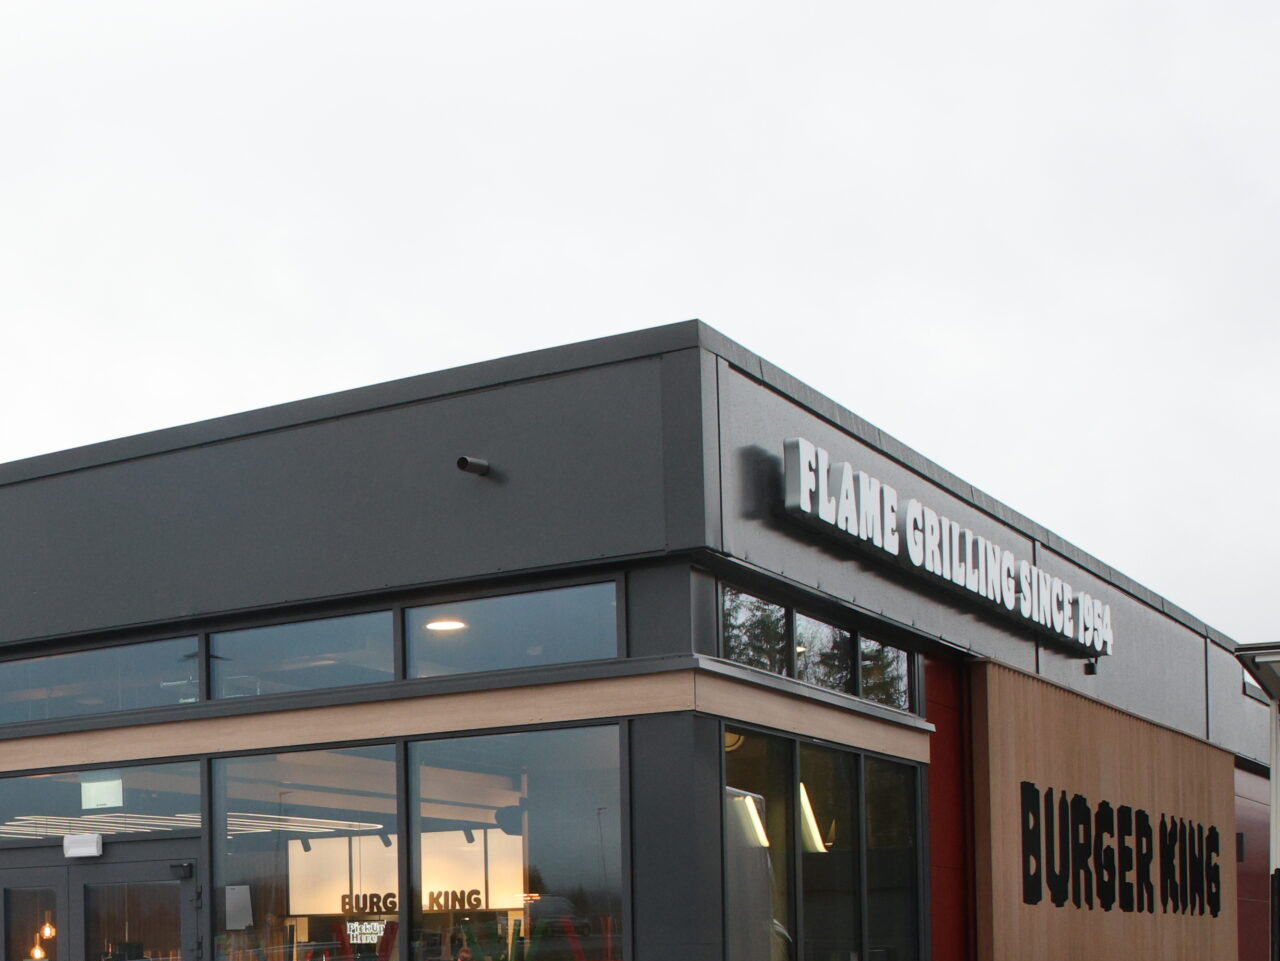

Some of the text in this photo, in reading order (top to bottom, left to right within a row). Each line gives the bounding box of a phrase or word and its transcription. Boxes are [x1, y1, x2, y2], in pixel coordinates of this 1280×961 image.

[786, 437, 1113, 656] FLAME GRILLING SINCE 1954
[341, 888, 482, 914] BURG KING
[1021, 781, 1220, 918] BURGER KING
